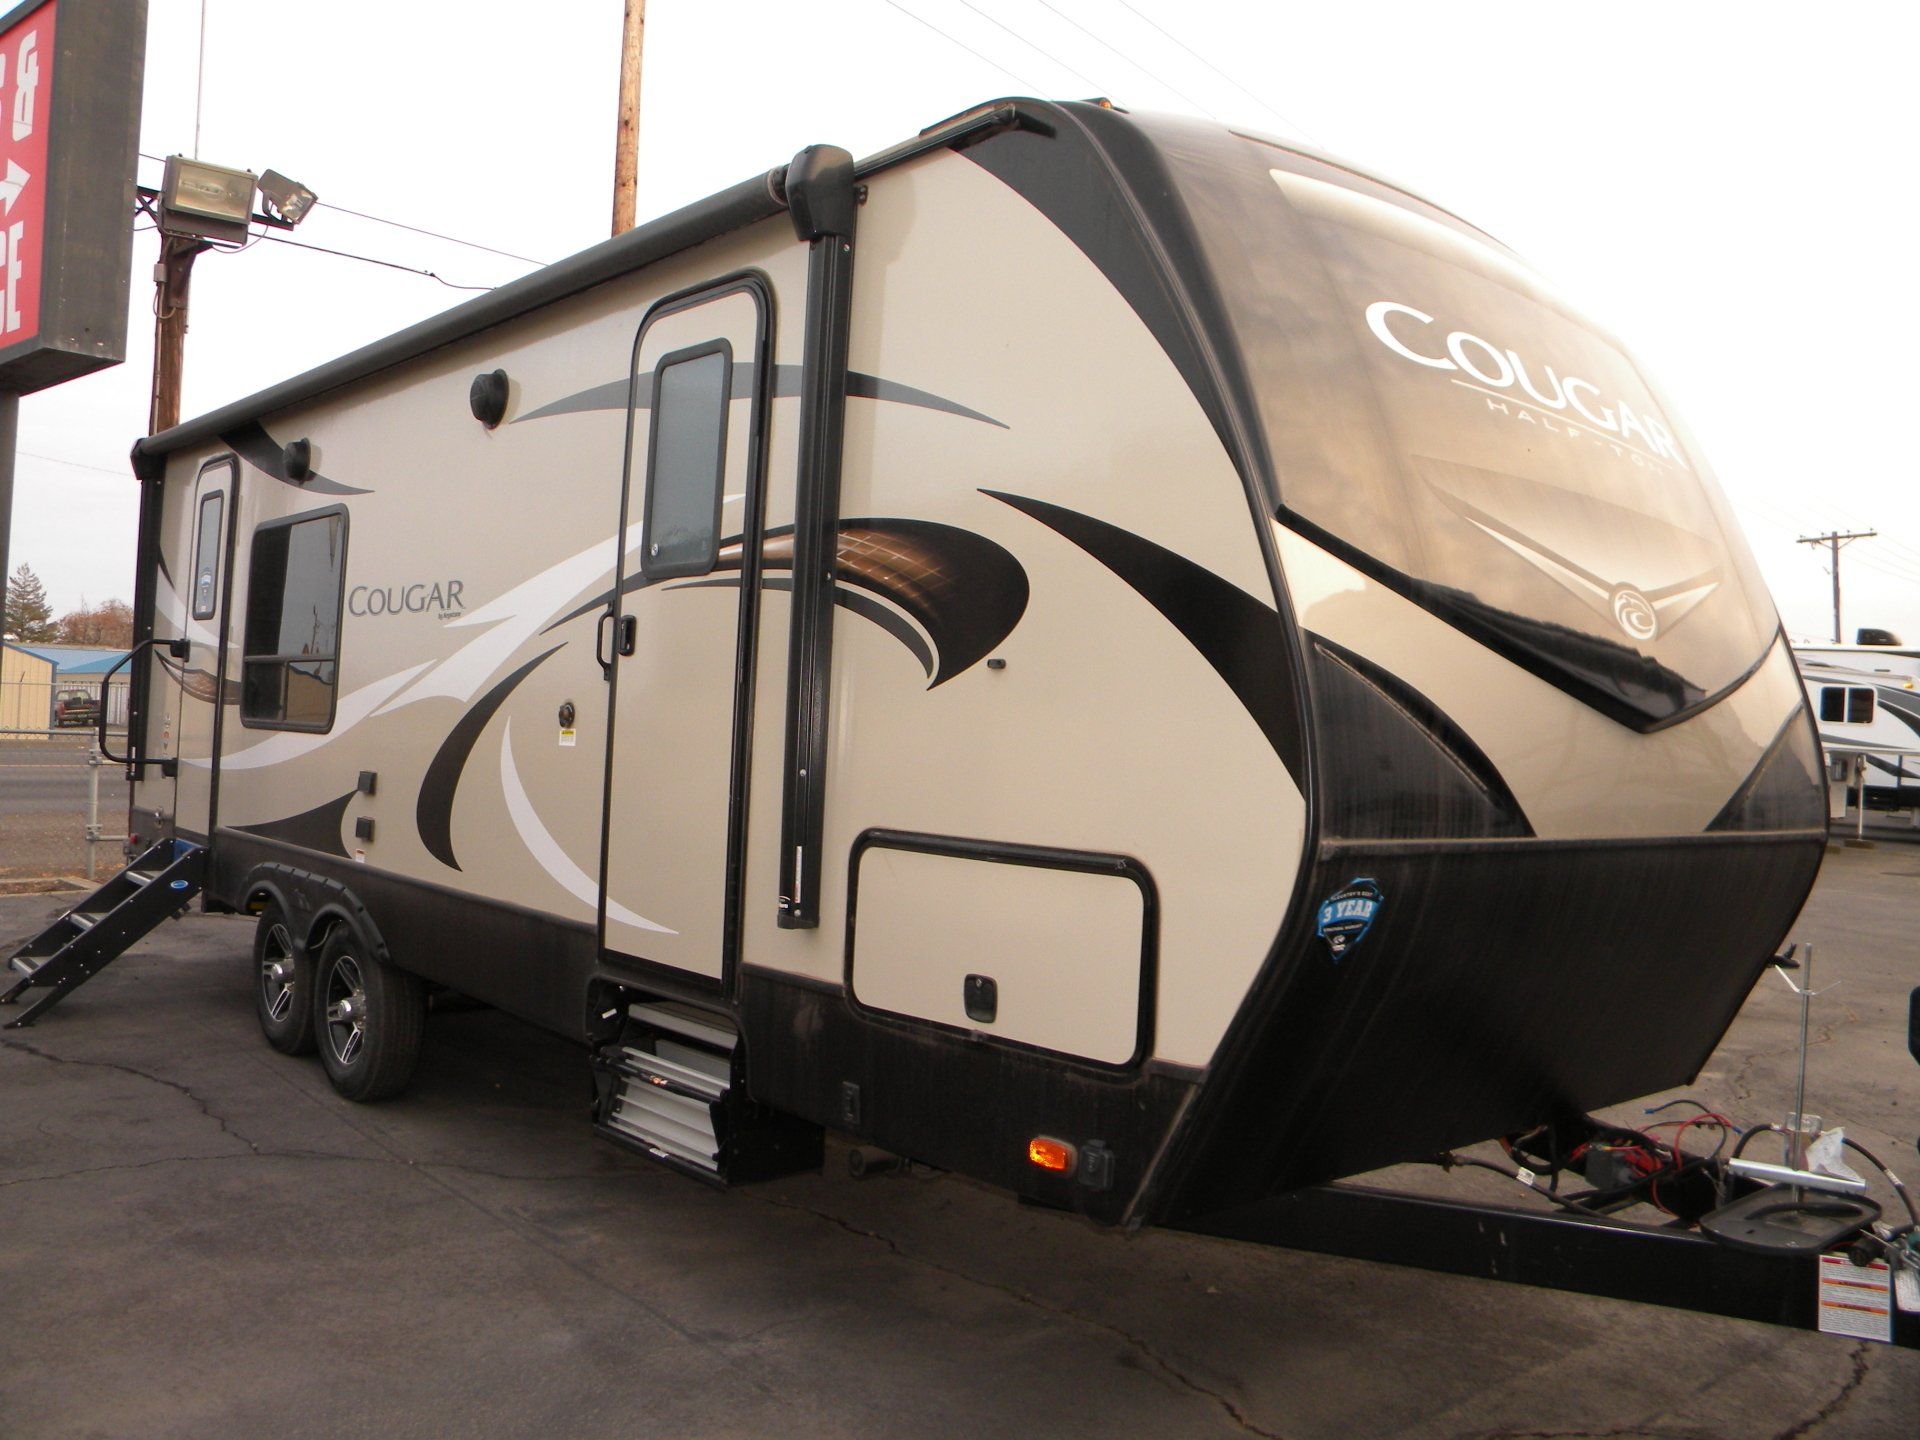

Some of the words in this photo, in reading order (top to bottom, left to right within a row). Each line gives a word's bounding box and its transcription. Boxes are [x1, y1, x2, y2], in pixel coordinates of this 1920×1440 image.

[1365, 301, 1690, 471] COUGAR
[348, 580, 466, 617] COUGAR
[1336, 899, 1373, 917] YEAR
